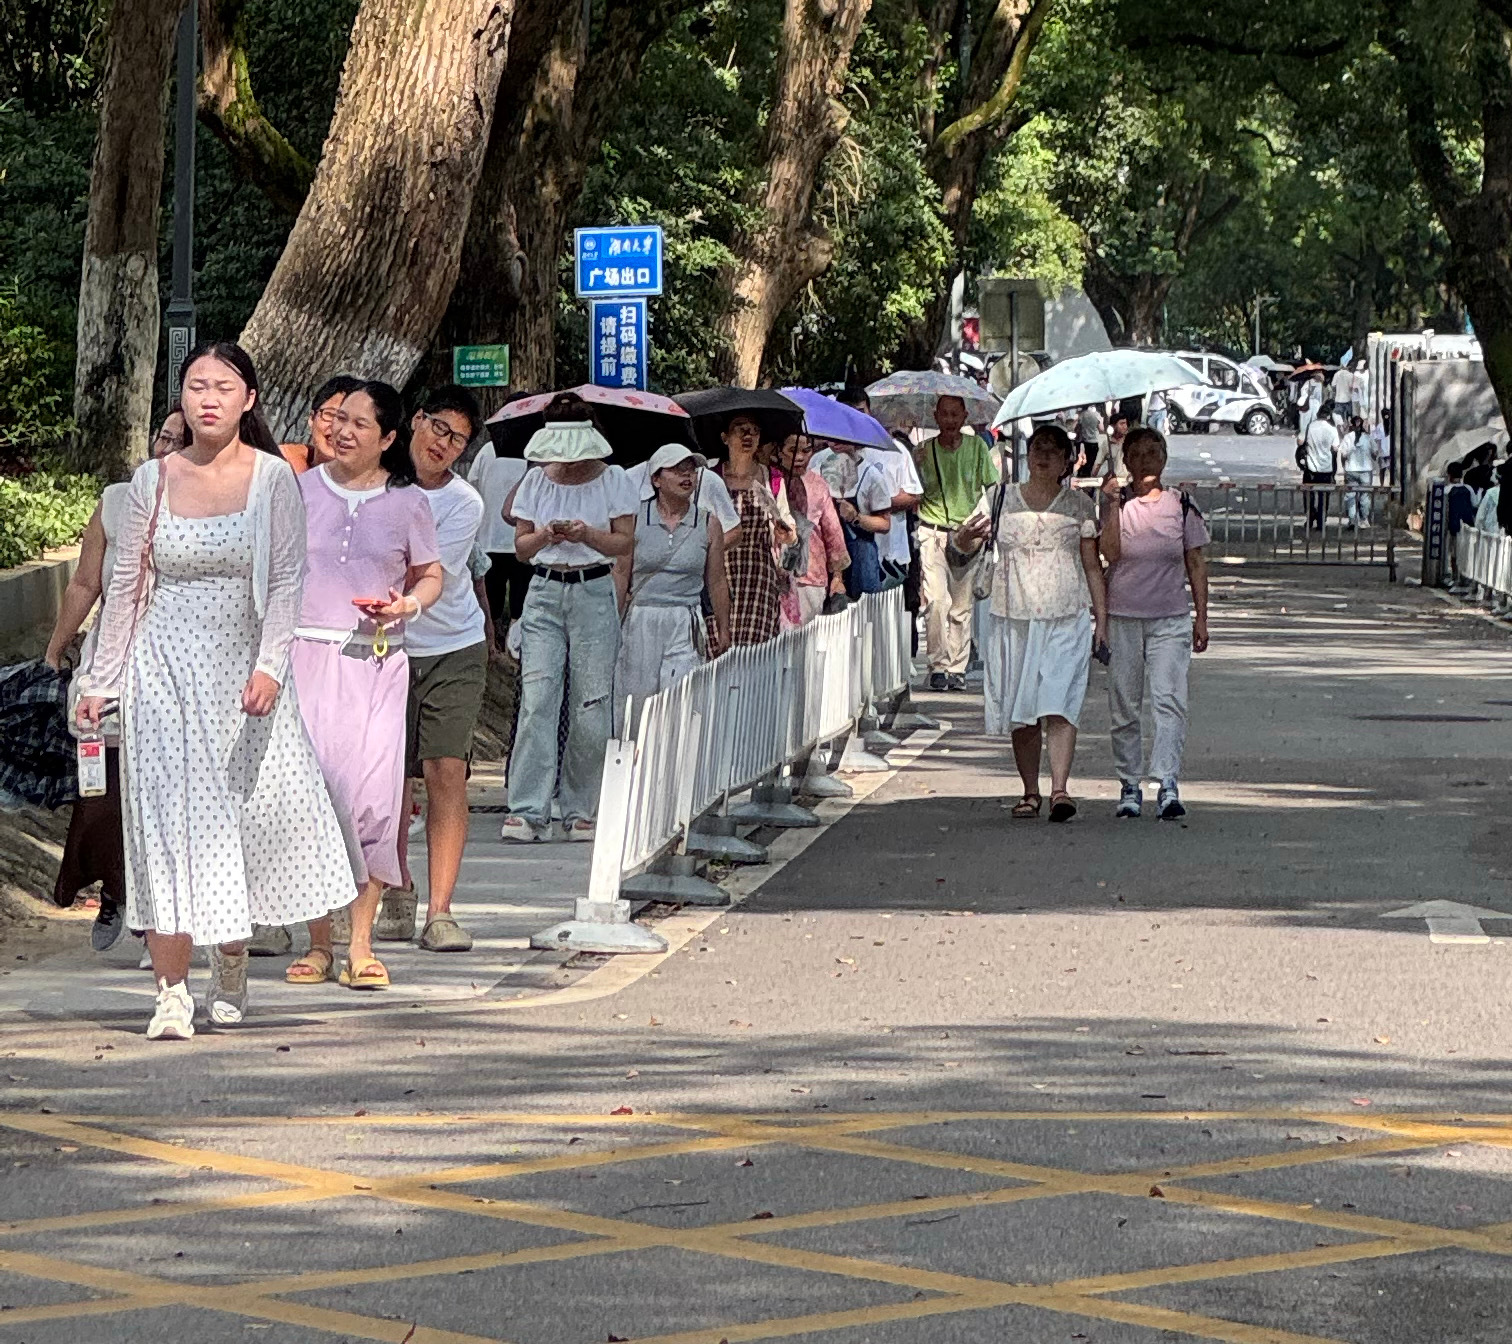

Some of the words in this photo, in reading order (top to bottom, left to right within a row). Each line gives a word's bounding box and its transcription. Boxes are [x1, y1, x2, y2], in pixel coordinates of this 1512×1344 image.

[588, 266, 650, 287] 广场出口
[600, 316, 617, 377] 请提前
[619, 305, 637, 386] 扫码缴费
